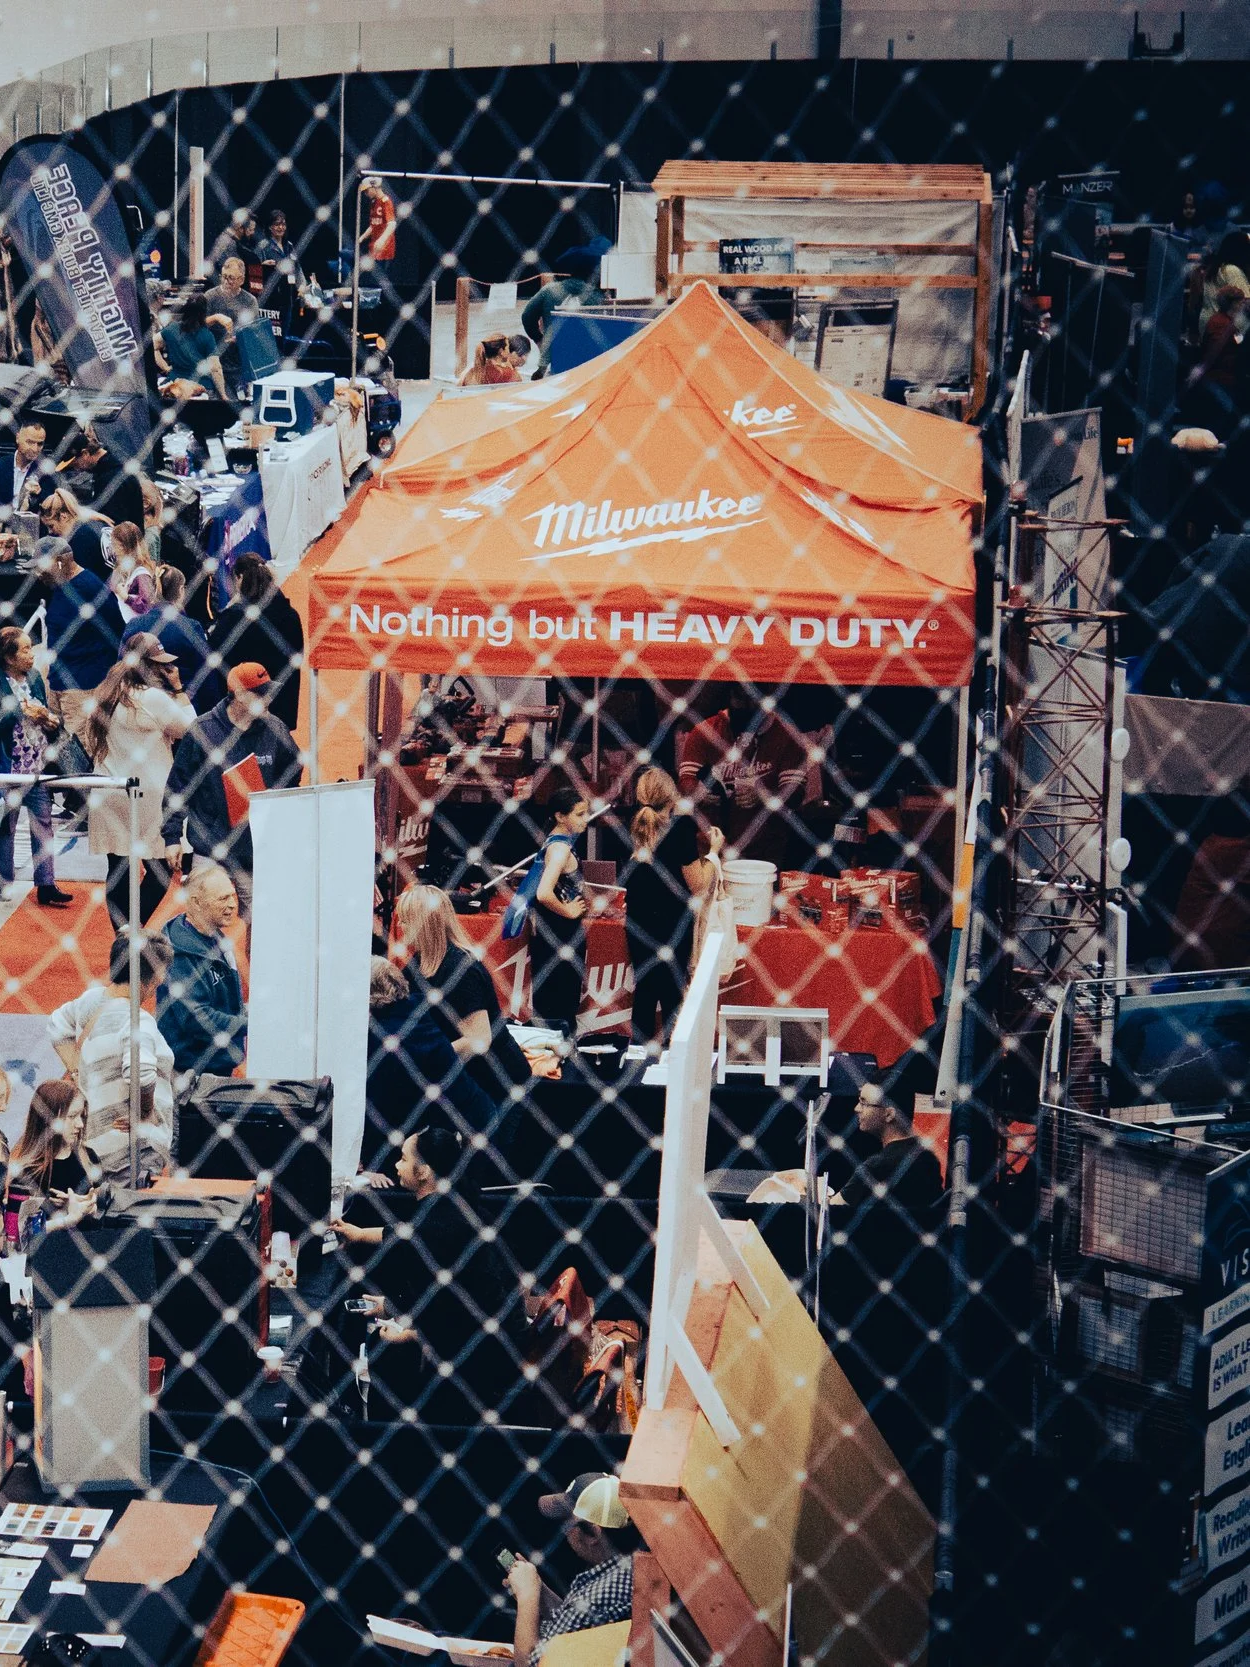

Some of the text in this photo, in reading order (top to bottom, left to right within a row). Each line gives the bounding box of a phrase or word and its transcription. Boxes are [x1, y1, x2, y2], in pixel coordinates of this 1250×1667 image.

[722, 245, 743, 254] REAL
[526, 490, 762, 549] Milwaukee
[349, 604, 513, 649] Nothing
[528, 608, 597, 641] but
[610, 611, 773, 646] HEAVY
[1223, 1358, 1248, 1386] WHAT
[1214, 1580, 1248, 1621] Math
